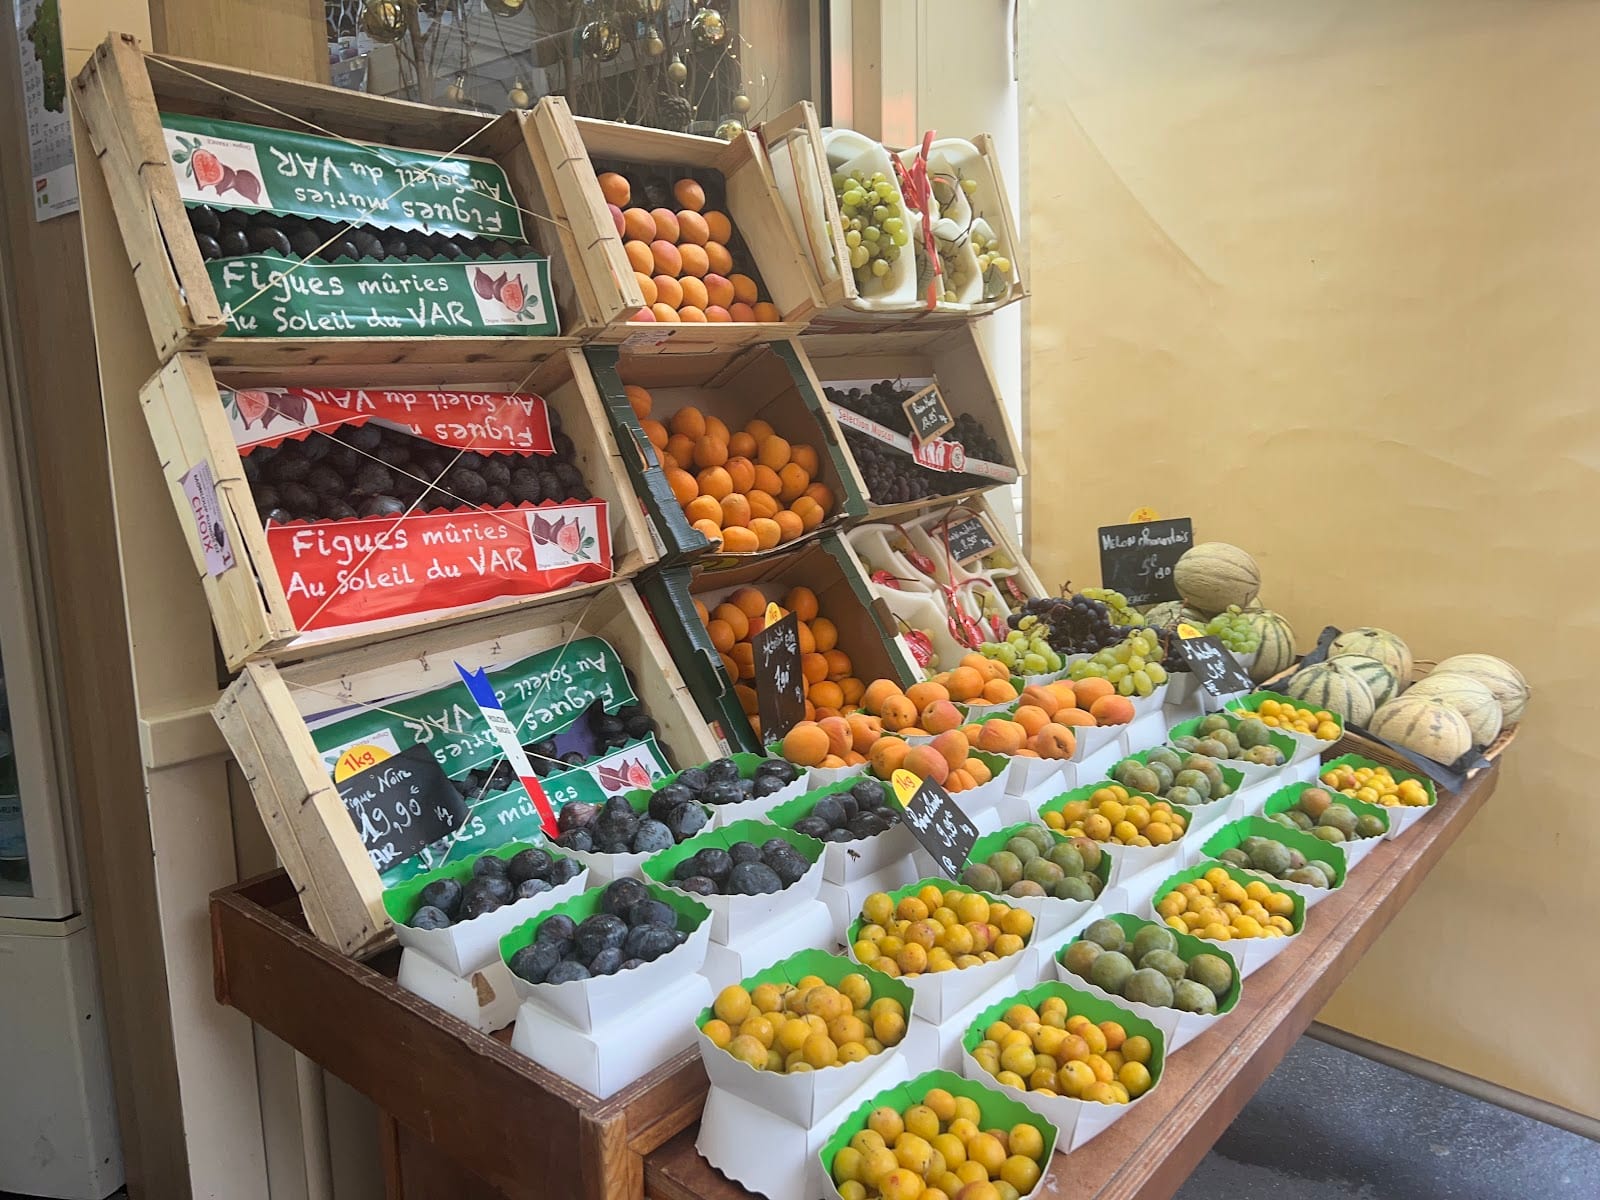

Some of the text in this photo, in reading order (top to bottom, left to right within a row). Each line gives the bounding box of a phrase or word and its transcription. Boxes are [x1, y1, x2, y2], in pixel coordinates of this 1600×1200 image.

[269, 146, 500, 201] Au Soleil du VAR
[295, 186, 502, 233] Figues mûries
[223, 261, 449, 303] Figues mûries
[222, 297, 472, 333] Au Soleil du VAR
[383, 391, 417, 412] du
[427, 391, 496, 414] Soleil
[503, 394, 534, 417] Au
[436, 416, 533, 448] Figues
[192, 495, 213, 553] CHOIX
[292, 522, 508, 565] Figues mûries
[286, 546, 527, 600] Au Soleil du VAR
[576, 651, 607, 673] Au
[514, 665, 573, 701] Soleil
[403, 704, 473, 745] VAR
[525, 683, 614, 731] Figues
[344, 751, 376, 772] 1kg
[435, 727, 499, 764] ûries
[896, 774, 916, 791] 1kg
[497, 786, 578, 826] mûies
